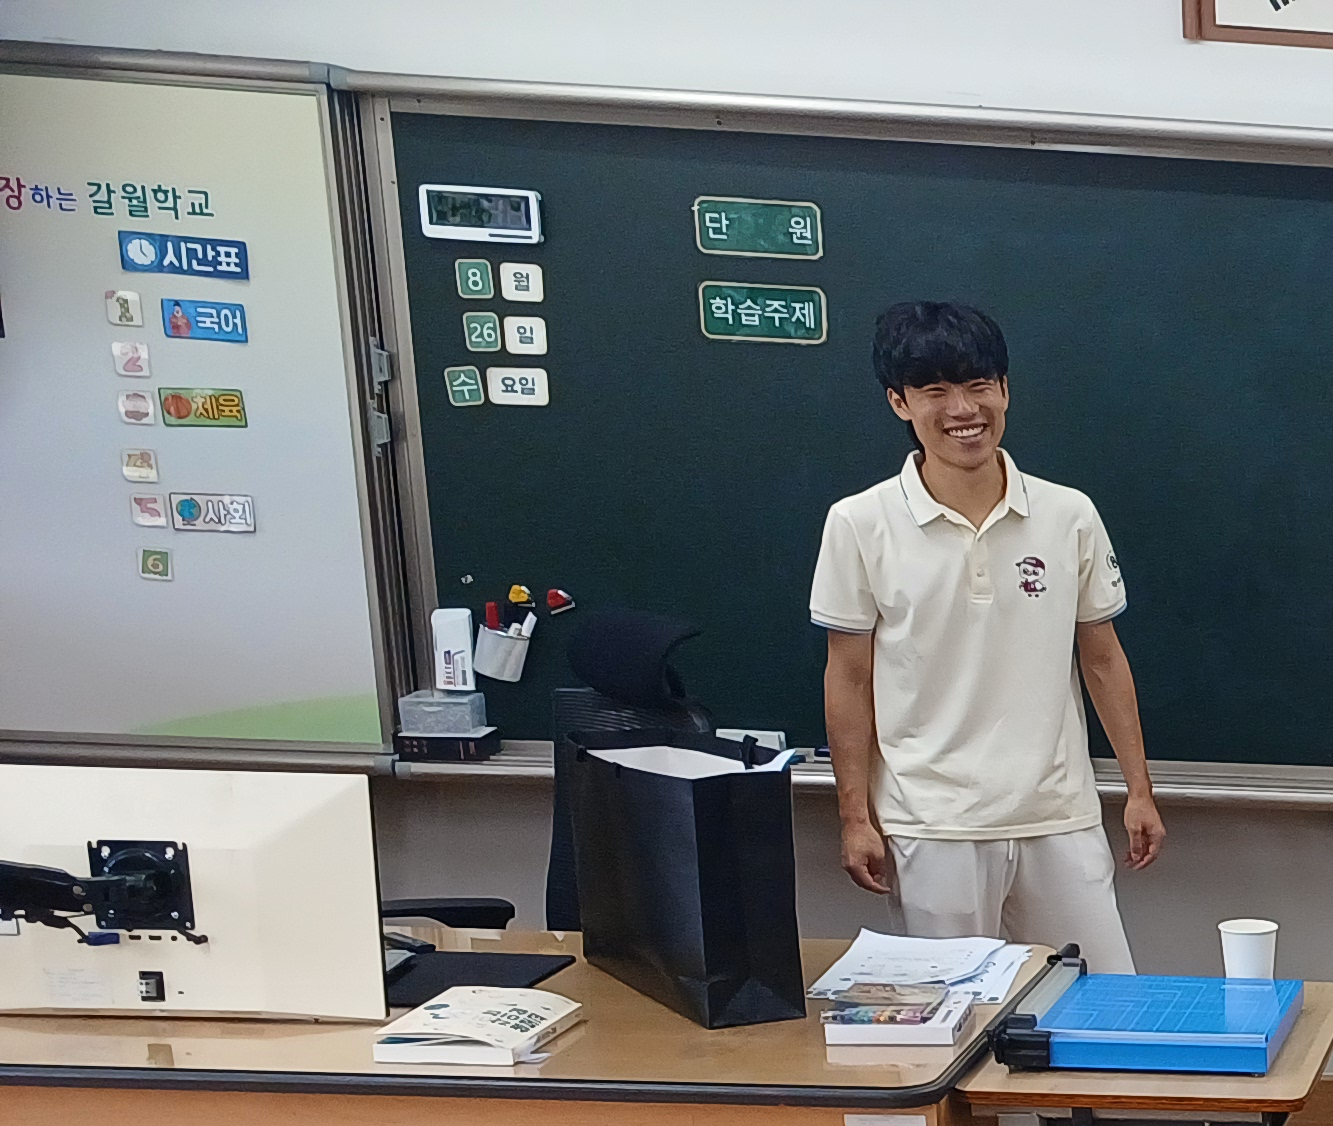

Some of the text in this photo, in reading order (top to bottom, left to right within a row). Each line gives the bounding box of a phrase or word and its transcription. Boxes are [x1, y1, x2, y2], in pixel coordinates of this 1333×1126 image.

[86, 181, 216, 221] 갈월학교
[705, 212, 813, 245] 단 원
[162, 241, 242, 273] 시간표
[466, 267, 531, 292] 8 월
[195, 307, 243, 335] 국어
[709, 296, 816, 330] 학습주제
[469, 322, 535, 345] 26 일
[452, 373, 536, 400] 수 요일
[204, 500, 251, 526] 사회
[146, 555, 164, 573] 6
